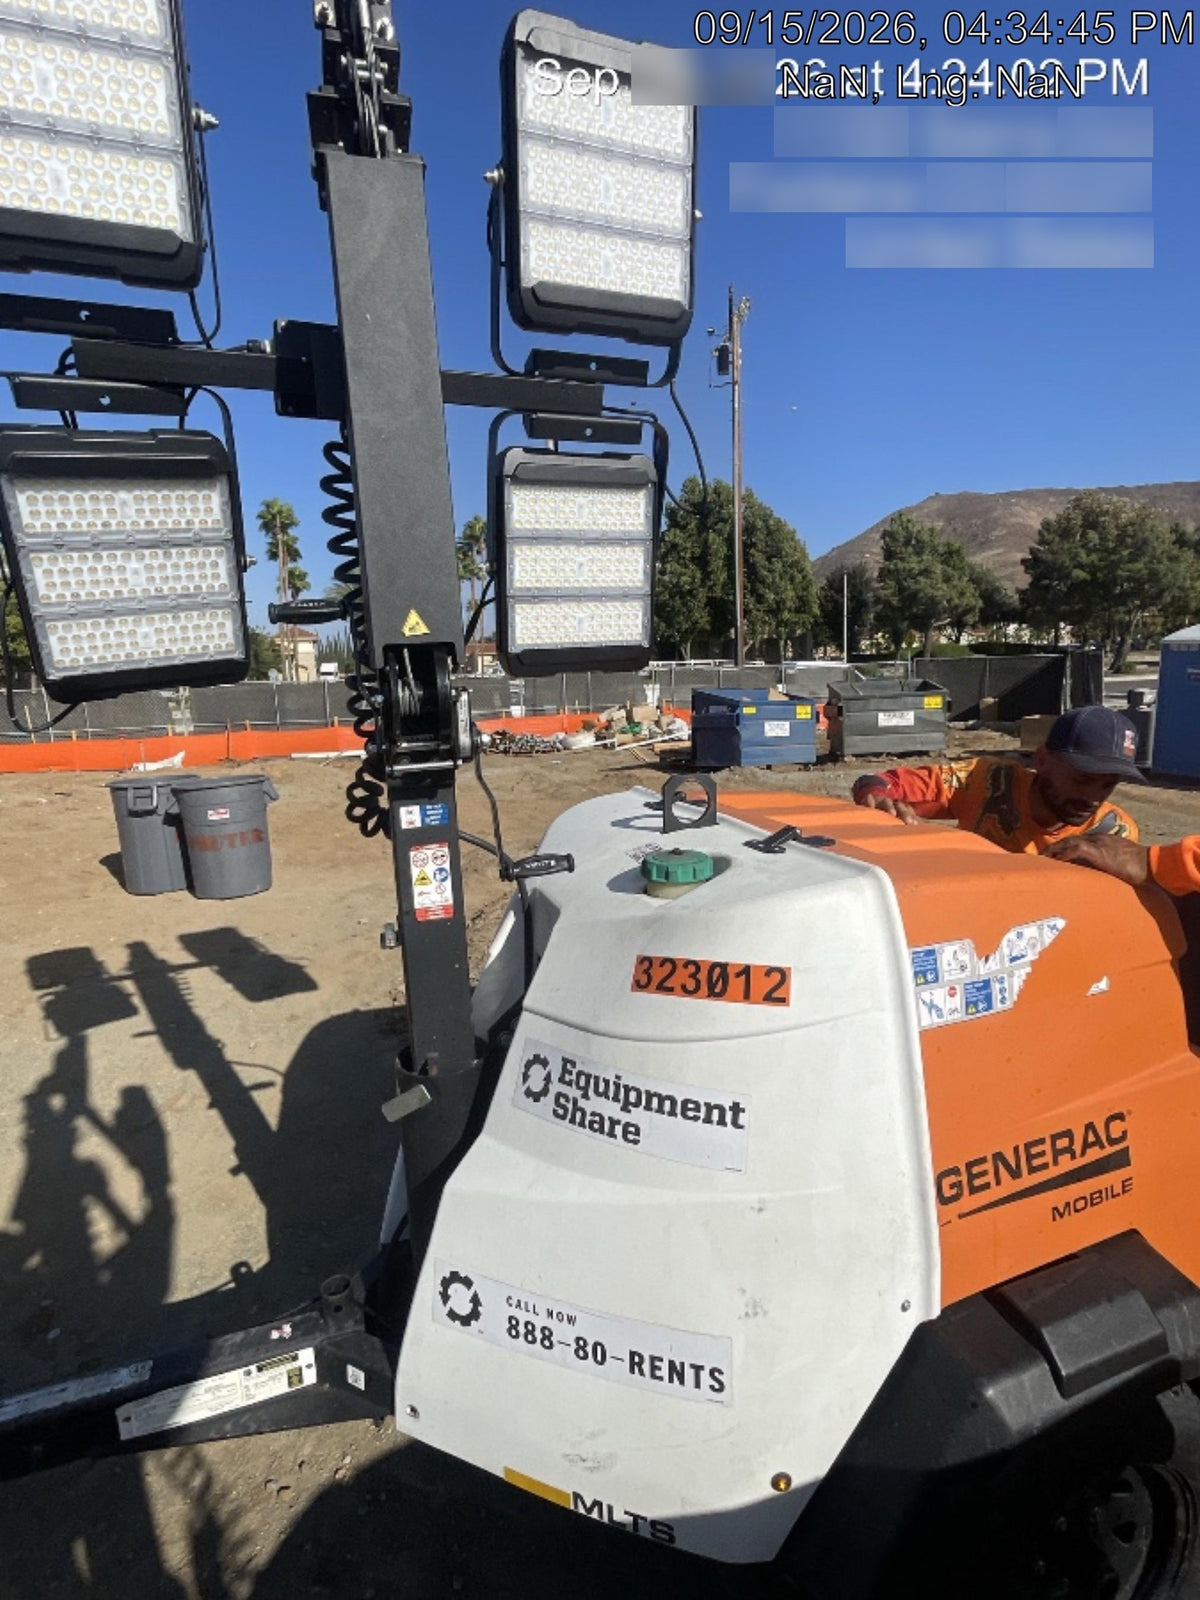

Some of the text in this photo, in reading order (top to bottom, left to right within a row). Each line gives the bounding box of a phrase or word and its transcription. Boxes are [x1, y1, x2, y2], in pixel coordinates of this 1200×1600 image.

[633, 955, 788, 1004] 323012
[552, 1090, 642, 1146] Share
[558, 1055, 747, 1130] Equipment
[935, 1110, 1130, 1206] GENERAC
[1051, 1176, 1134, 1222] MOBILE
[505, 1294, 578, 1327] CALL NOW
[506, 1314, 726, 1394] 888-80-RENTS
[571, 1490, 677, 1545] MLTS
